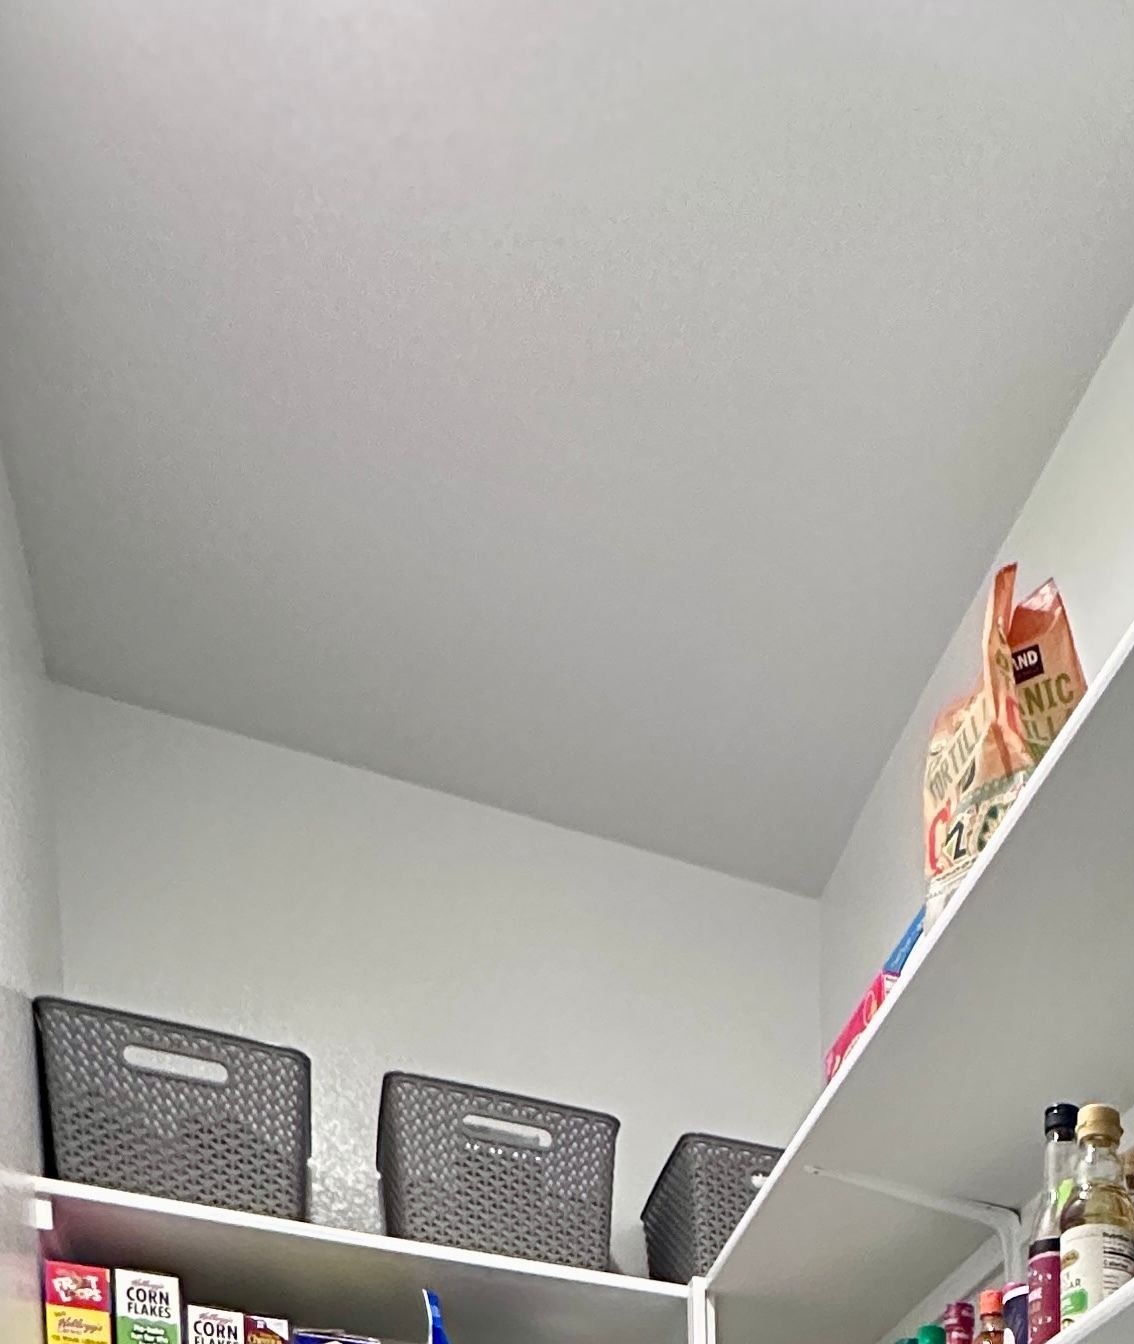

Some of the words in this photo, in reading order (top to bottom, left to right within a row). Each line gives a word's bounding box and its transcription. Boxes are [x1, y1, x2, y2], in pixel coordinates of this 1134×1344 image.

[126, 1286, 171, 1307] CORN
[127, 1301, 172, 1319] FLAKES
[193, 1319, 239, 1341] CORN
